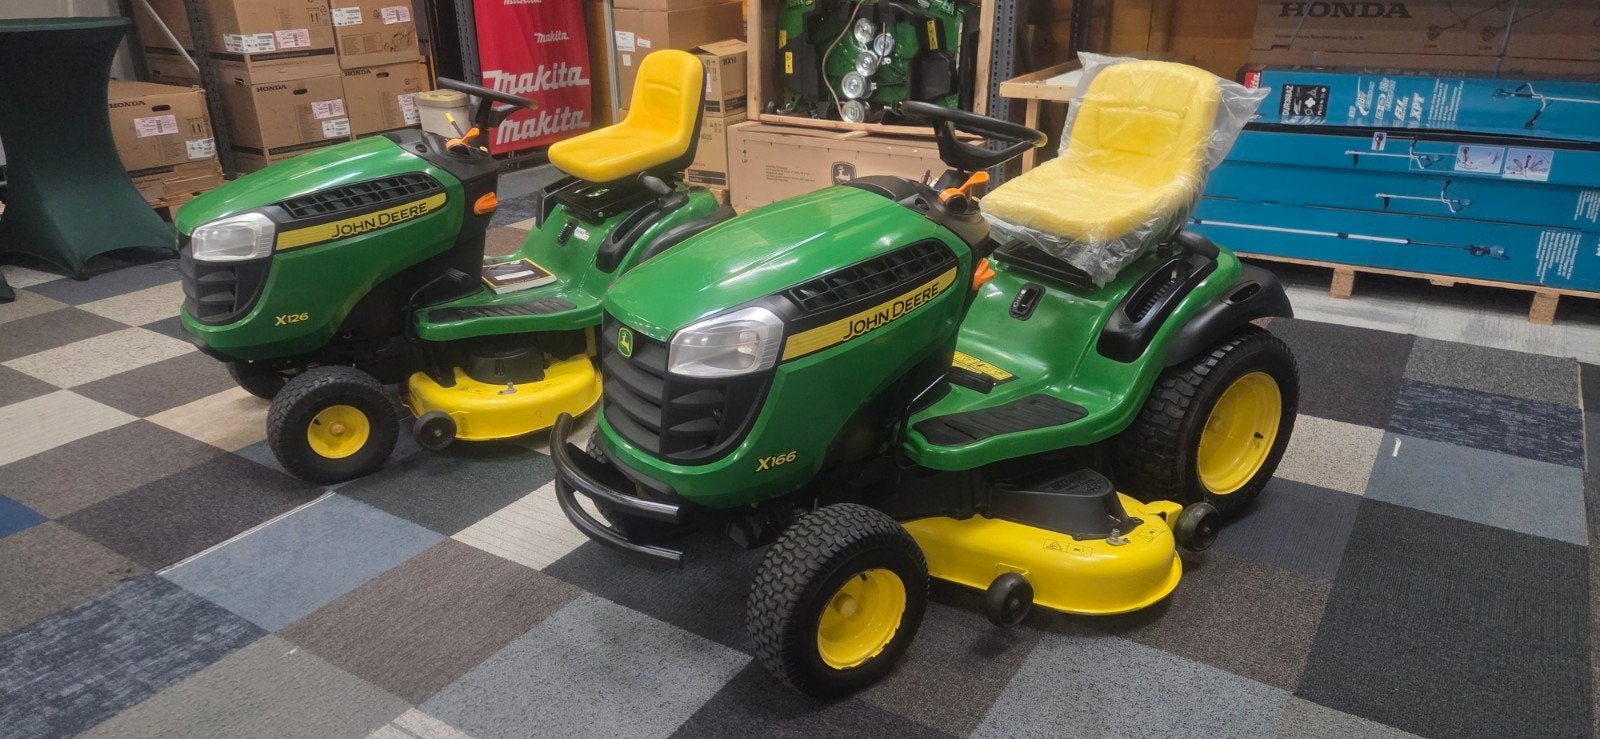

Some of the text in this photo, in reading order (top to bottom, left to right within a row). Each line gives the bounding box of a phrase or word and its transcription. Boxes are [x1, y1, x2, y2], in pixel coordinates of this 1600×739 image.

[1278, 1, 1413, 19] HONDA
[256, 84, 287, 93] HONDA
[109, 101, 146, 109] HONDA
[331, 202, 429, 239] JOHN DEERE
[275, 312, 310, 327] X126
[843, 281, 941, 341] JOHN DEERE
[755, 451, 798, 473] X166
